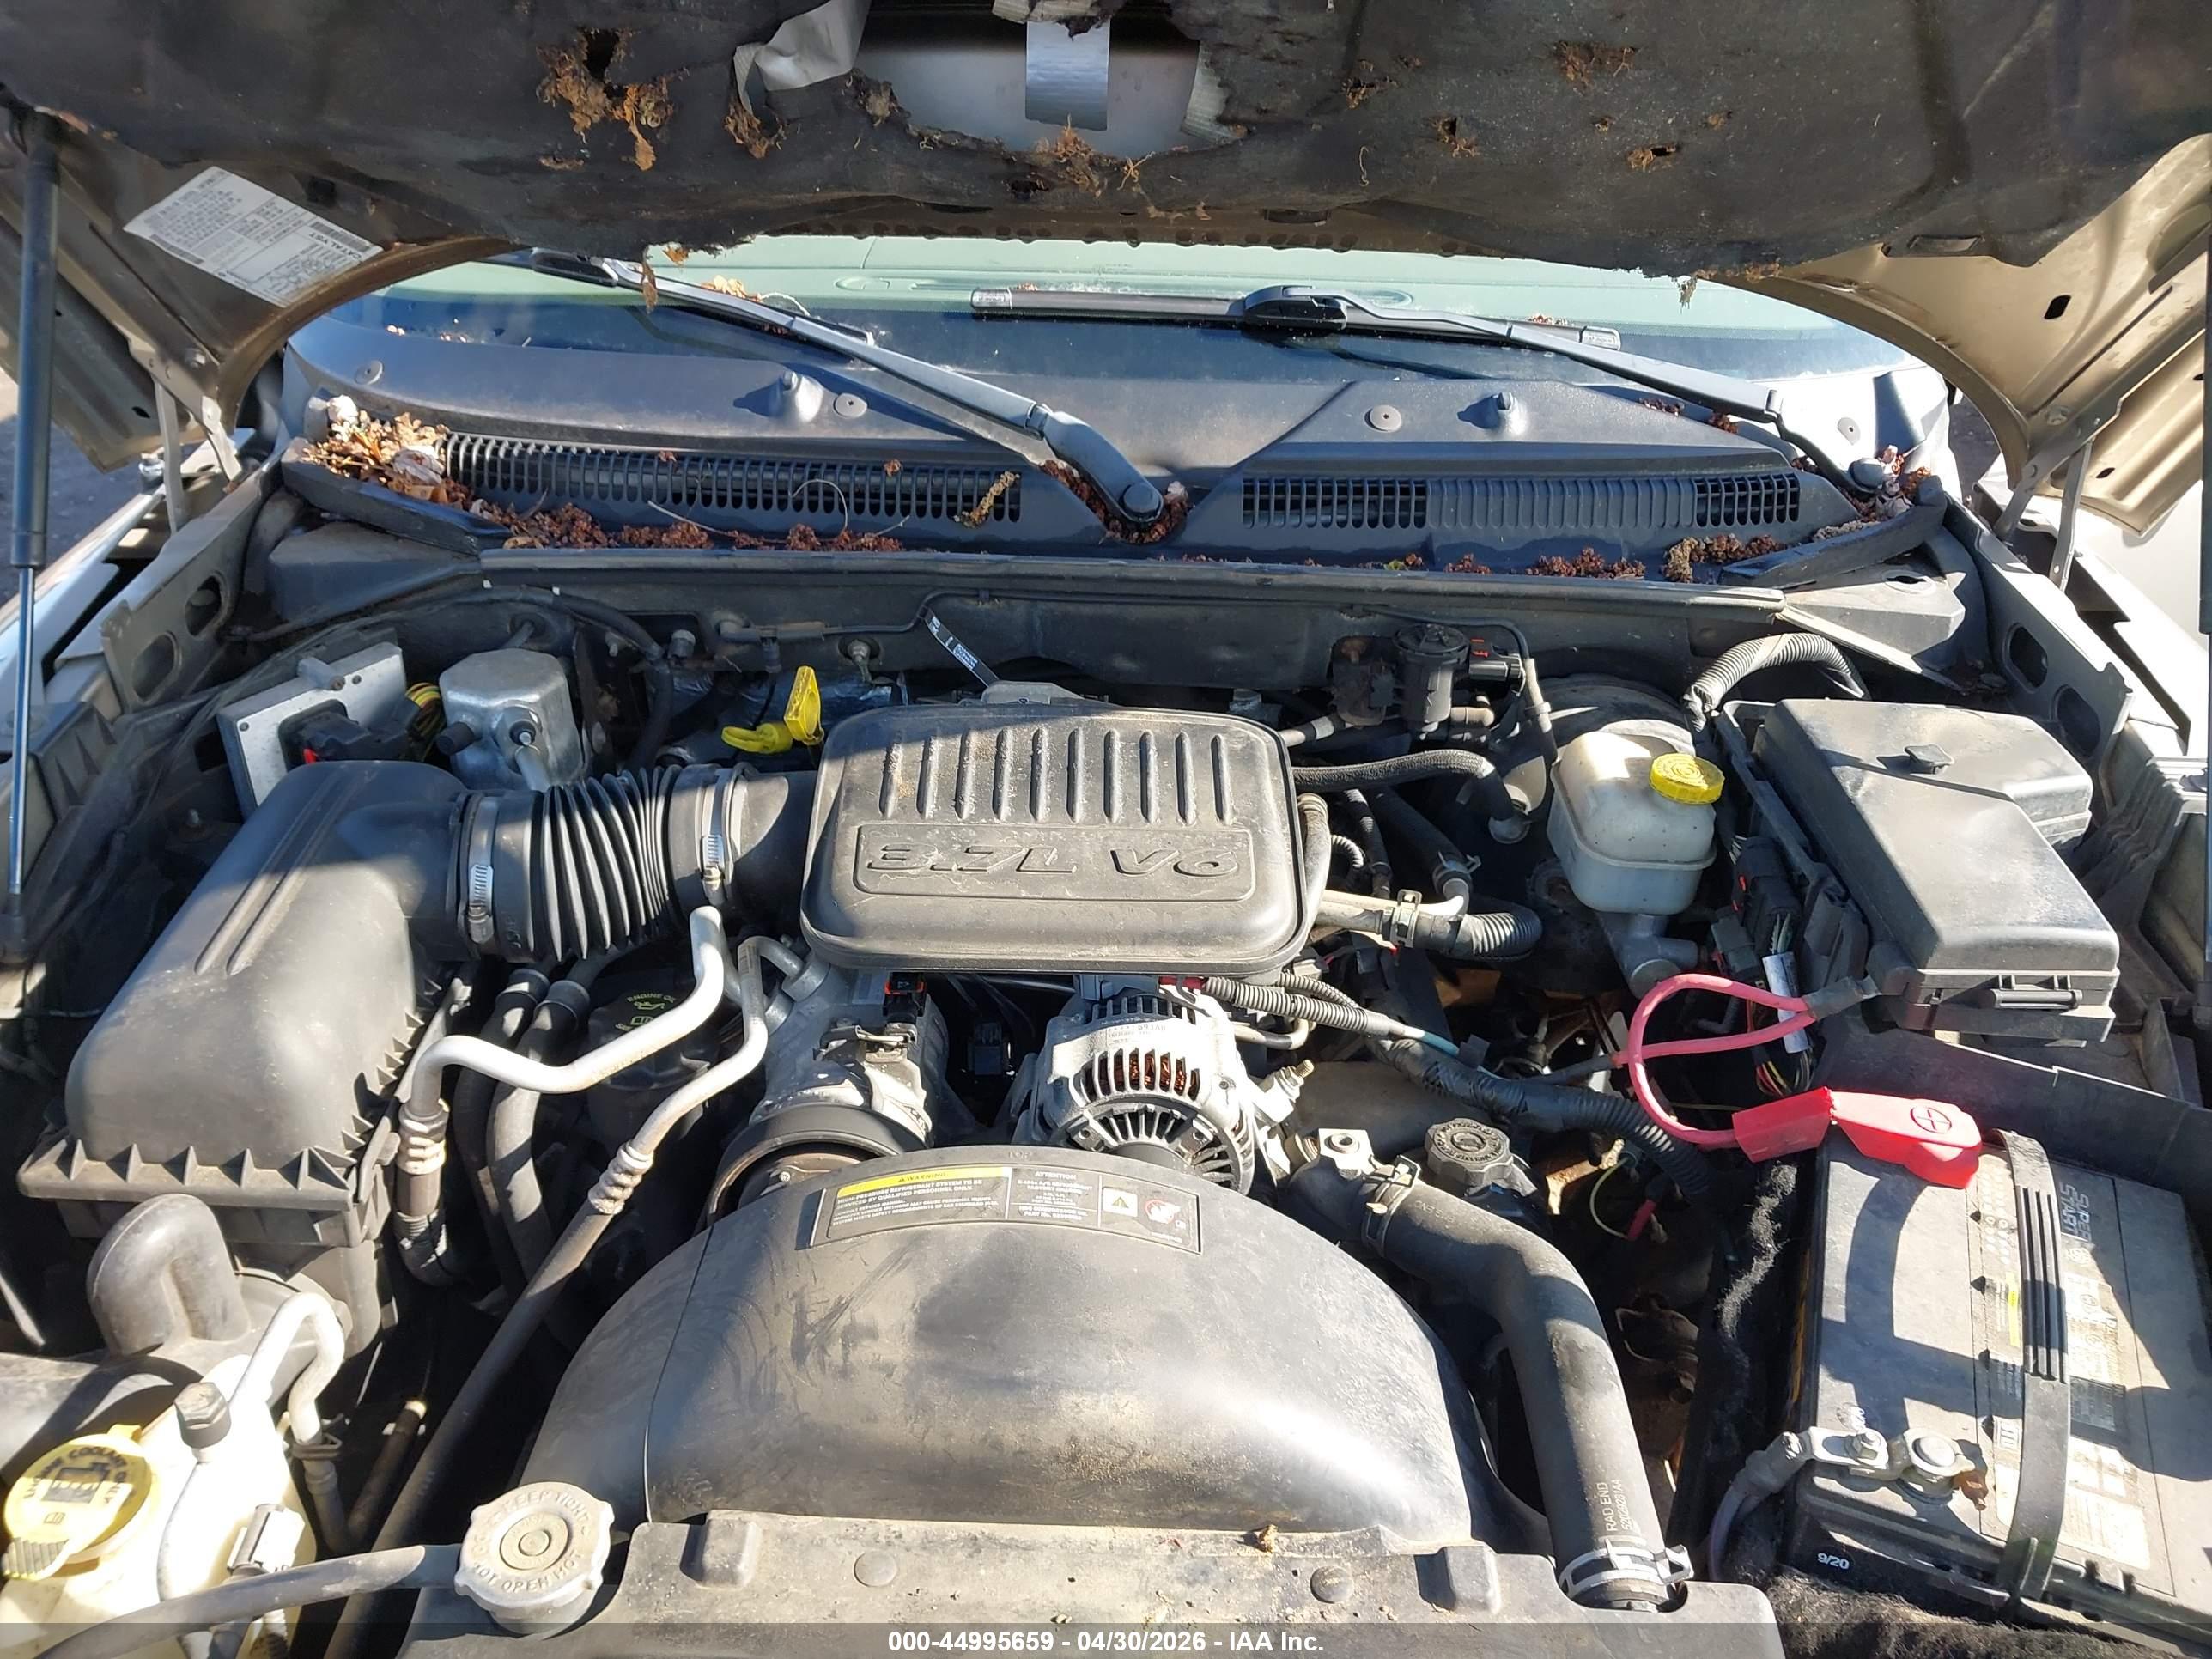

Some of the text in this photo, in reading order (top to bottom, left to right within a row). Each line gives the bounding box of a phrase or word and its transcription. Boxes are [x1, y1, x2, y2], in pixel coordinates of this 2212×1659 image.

[866, 843, 1239, 878] 3.7L V6
[627, 993, 663, 1002] ENGINE
[907, 1172, 946, 1182] WARNING
[1035, 1170, 1077, 1180] ATTENTION
[2059, 1182, 2079, 1237] START
[2074, 1193, 2092, 1243] SUPER
[69, 1446, 127, 1468] COOLANT
[1595, 1482, 1618, 1532] RAD END
[1817, 1552, 1850, 1570] 9/20
[501, 1577, 550, 1594] OPEN
